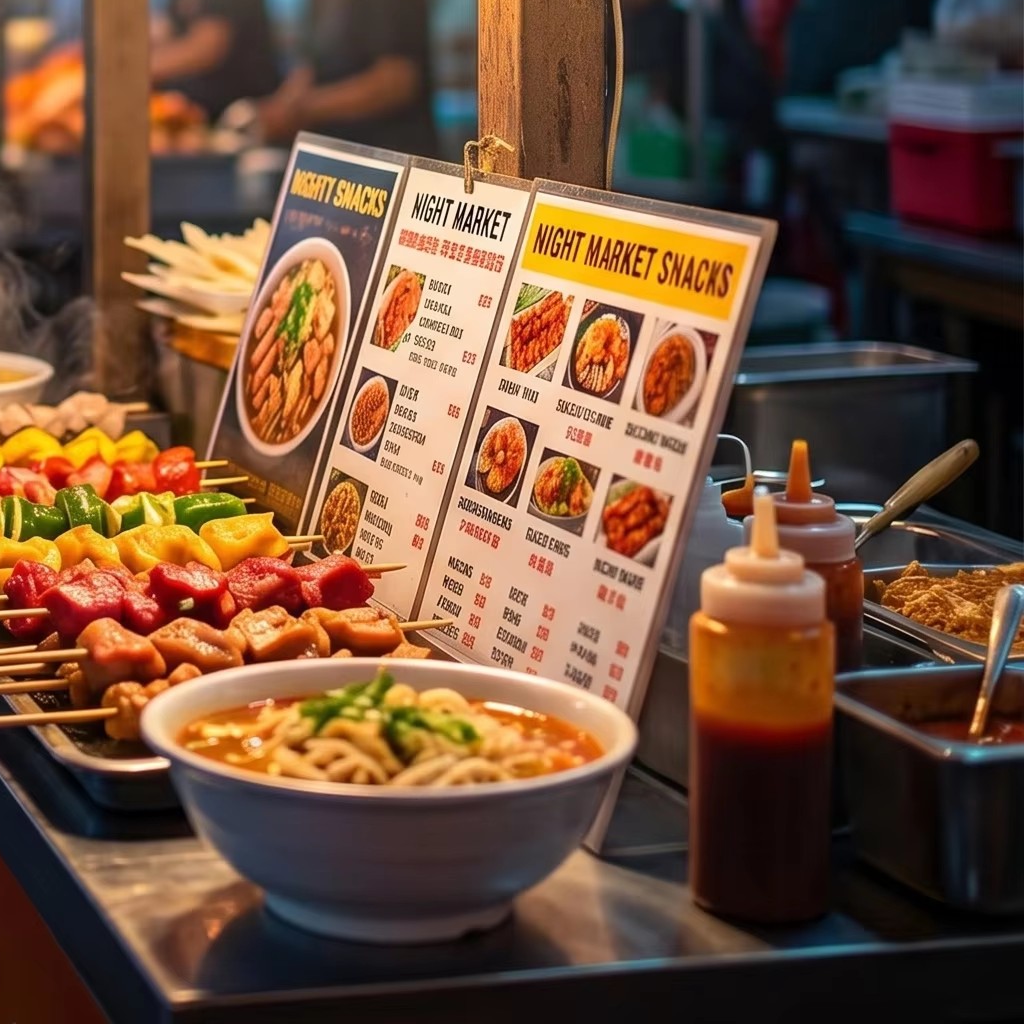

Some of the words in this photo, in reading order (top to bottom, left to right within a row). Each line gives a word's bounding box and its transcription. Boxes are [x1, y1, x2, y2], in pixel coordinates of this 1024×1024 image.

[333, 179, 388, 218] SNACKS
[410, 192, 455, 227] NIGHT
[451, 201, 512, 242] MARKET
[532, 223, 586, 263] NIGHT
[583, 234, 658, 281] MARKET
[657, 250, 734, 298] SNACKS
